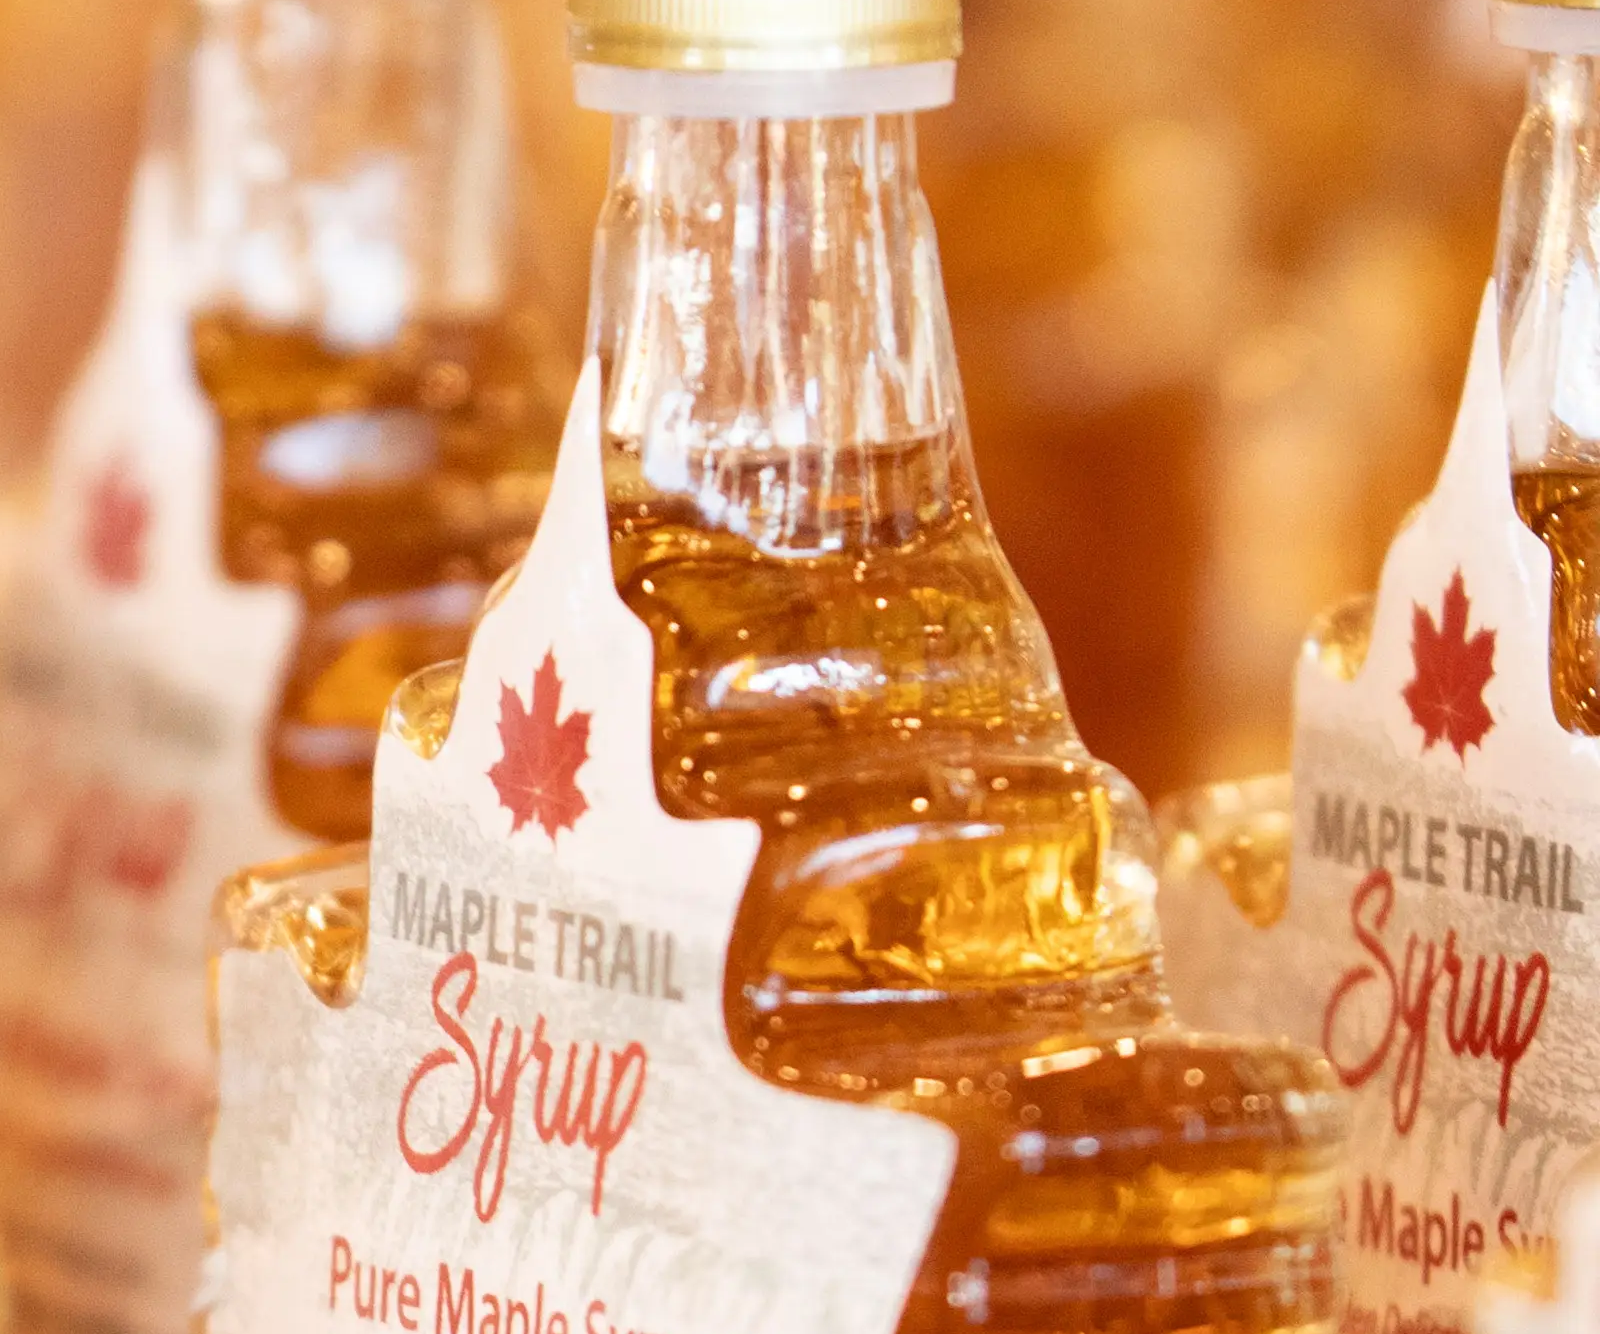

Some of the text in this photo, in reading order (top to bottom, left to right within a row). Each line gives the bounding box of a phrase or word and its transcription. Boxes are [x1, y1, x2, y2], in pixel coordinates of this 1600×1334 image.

[1311, 792, 1584, 914] MAPLE TRAIL
[391, 871, 685, 1003] MAPLE TRAIL
[1321, 867, 1551, 1136] Syrup
[397, 951, 647, 1223] Syrup
[329, 1234, 421, 1332] Pure
[1357, 1172, 1485, 1285] Maple
